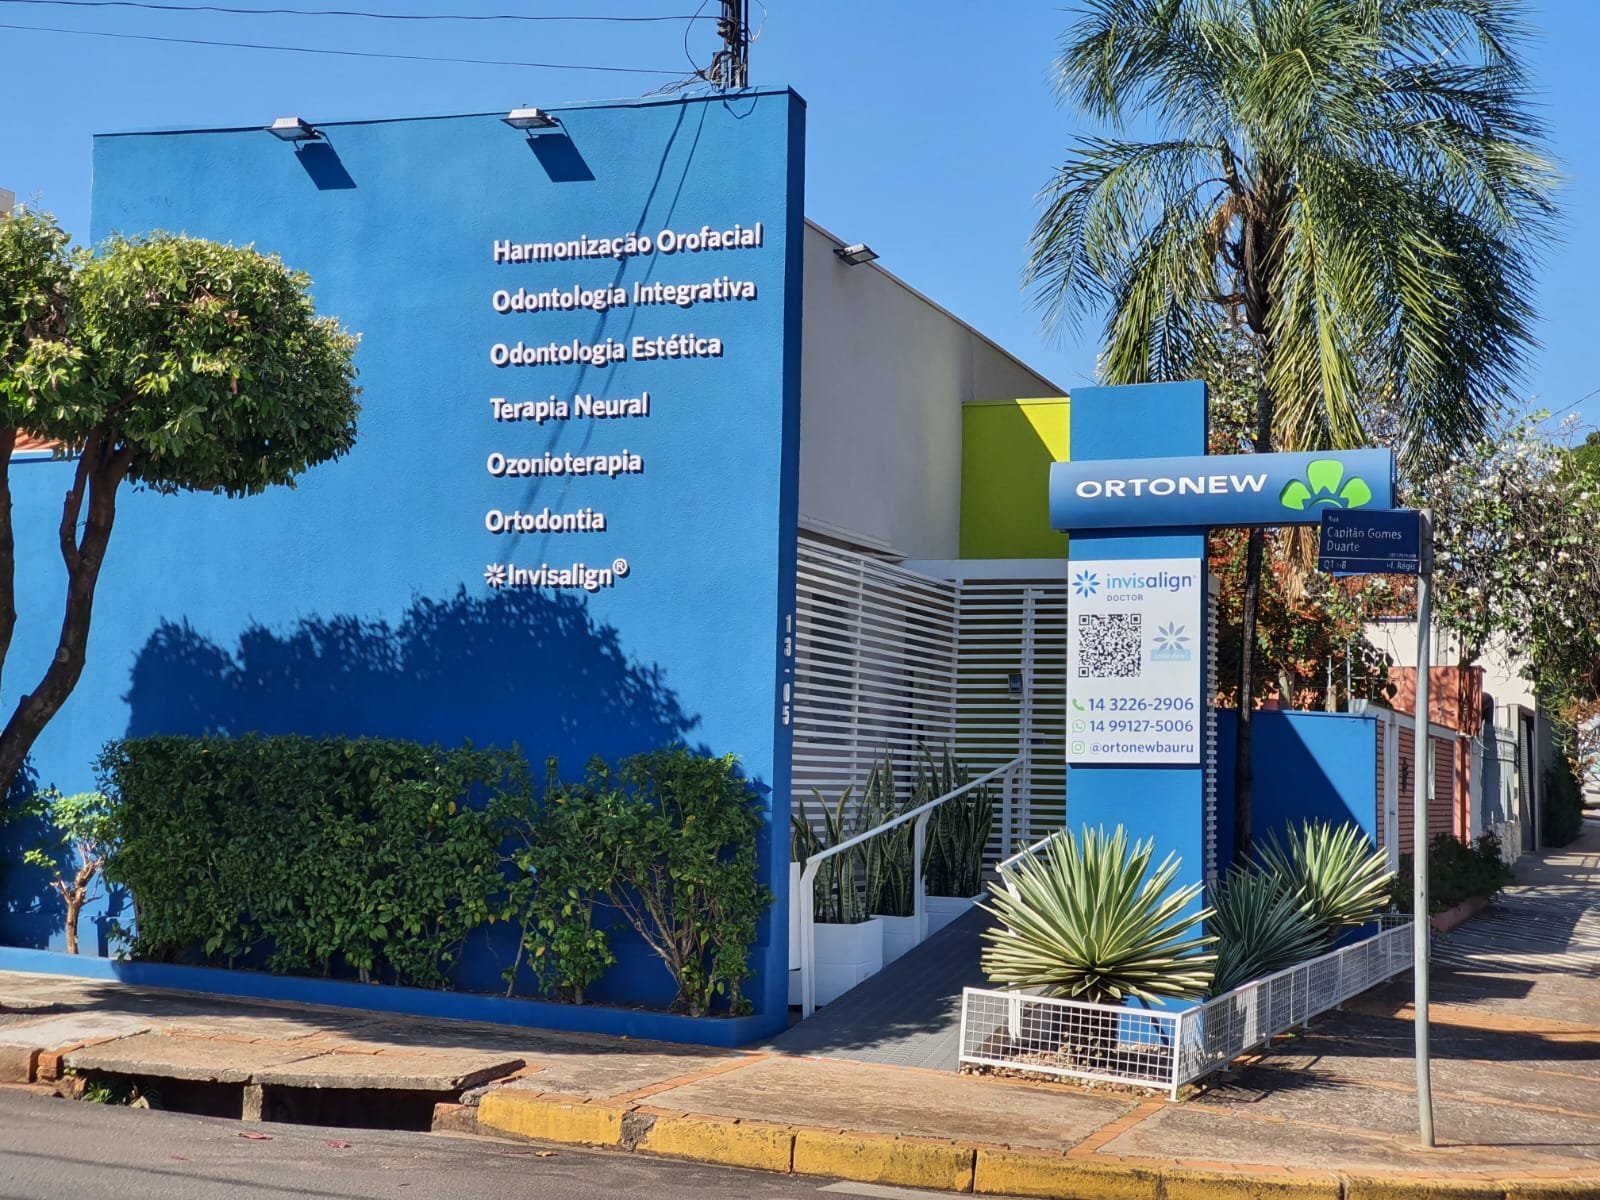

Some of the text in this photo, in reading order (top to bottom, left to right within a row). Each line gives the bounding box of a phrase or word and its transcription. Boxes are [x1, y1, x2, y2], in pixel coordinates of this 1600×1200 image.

[493, 222, 762, 261] Harmonização Orofacial
[492, 276, 756, 312] Odontologia Integrativa
[490, 333, 722, 365] Odontologia Estética
[490, 392, 649, 421] Terapia Neural
[486, 449, 643, 476] Ozonioterapia
[1075, 473, 1268, 499] ORTONEW
[485, 507, 605, 531] Ortodontia
[1327, 526, 1402, 540] Capitão Gomes
[1326, 540, 1360, 552] Duarte
[1106, 572, 1192, 592] invisalign
[1107, 594, 1144, 602] DOCTOR
[1088, 697, 1194, 711] 14 3226-2906
[1089, 719, 1194, 733] 14 99127-5006
[1090, 741, 1194, 755] @ortonewbauru
